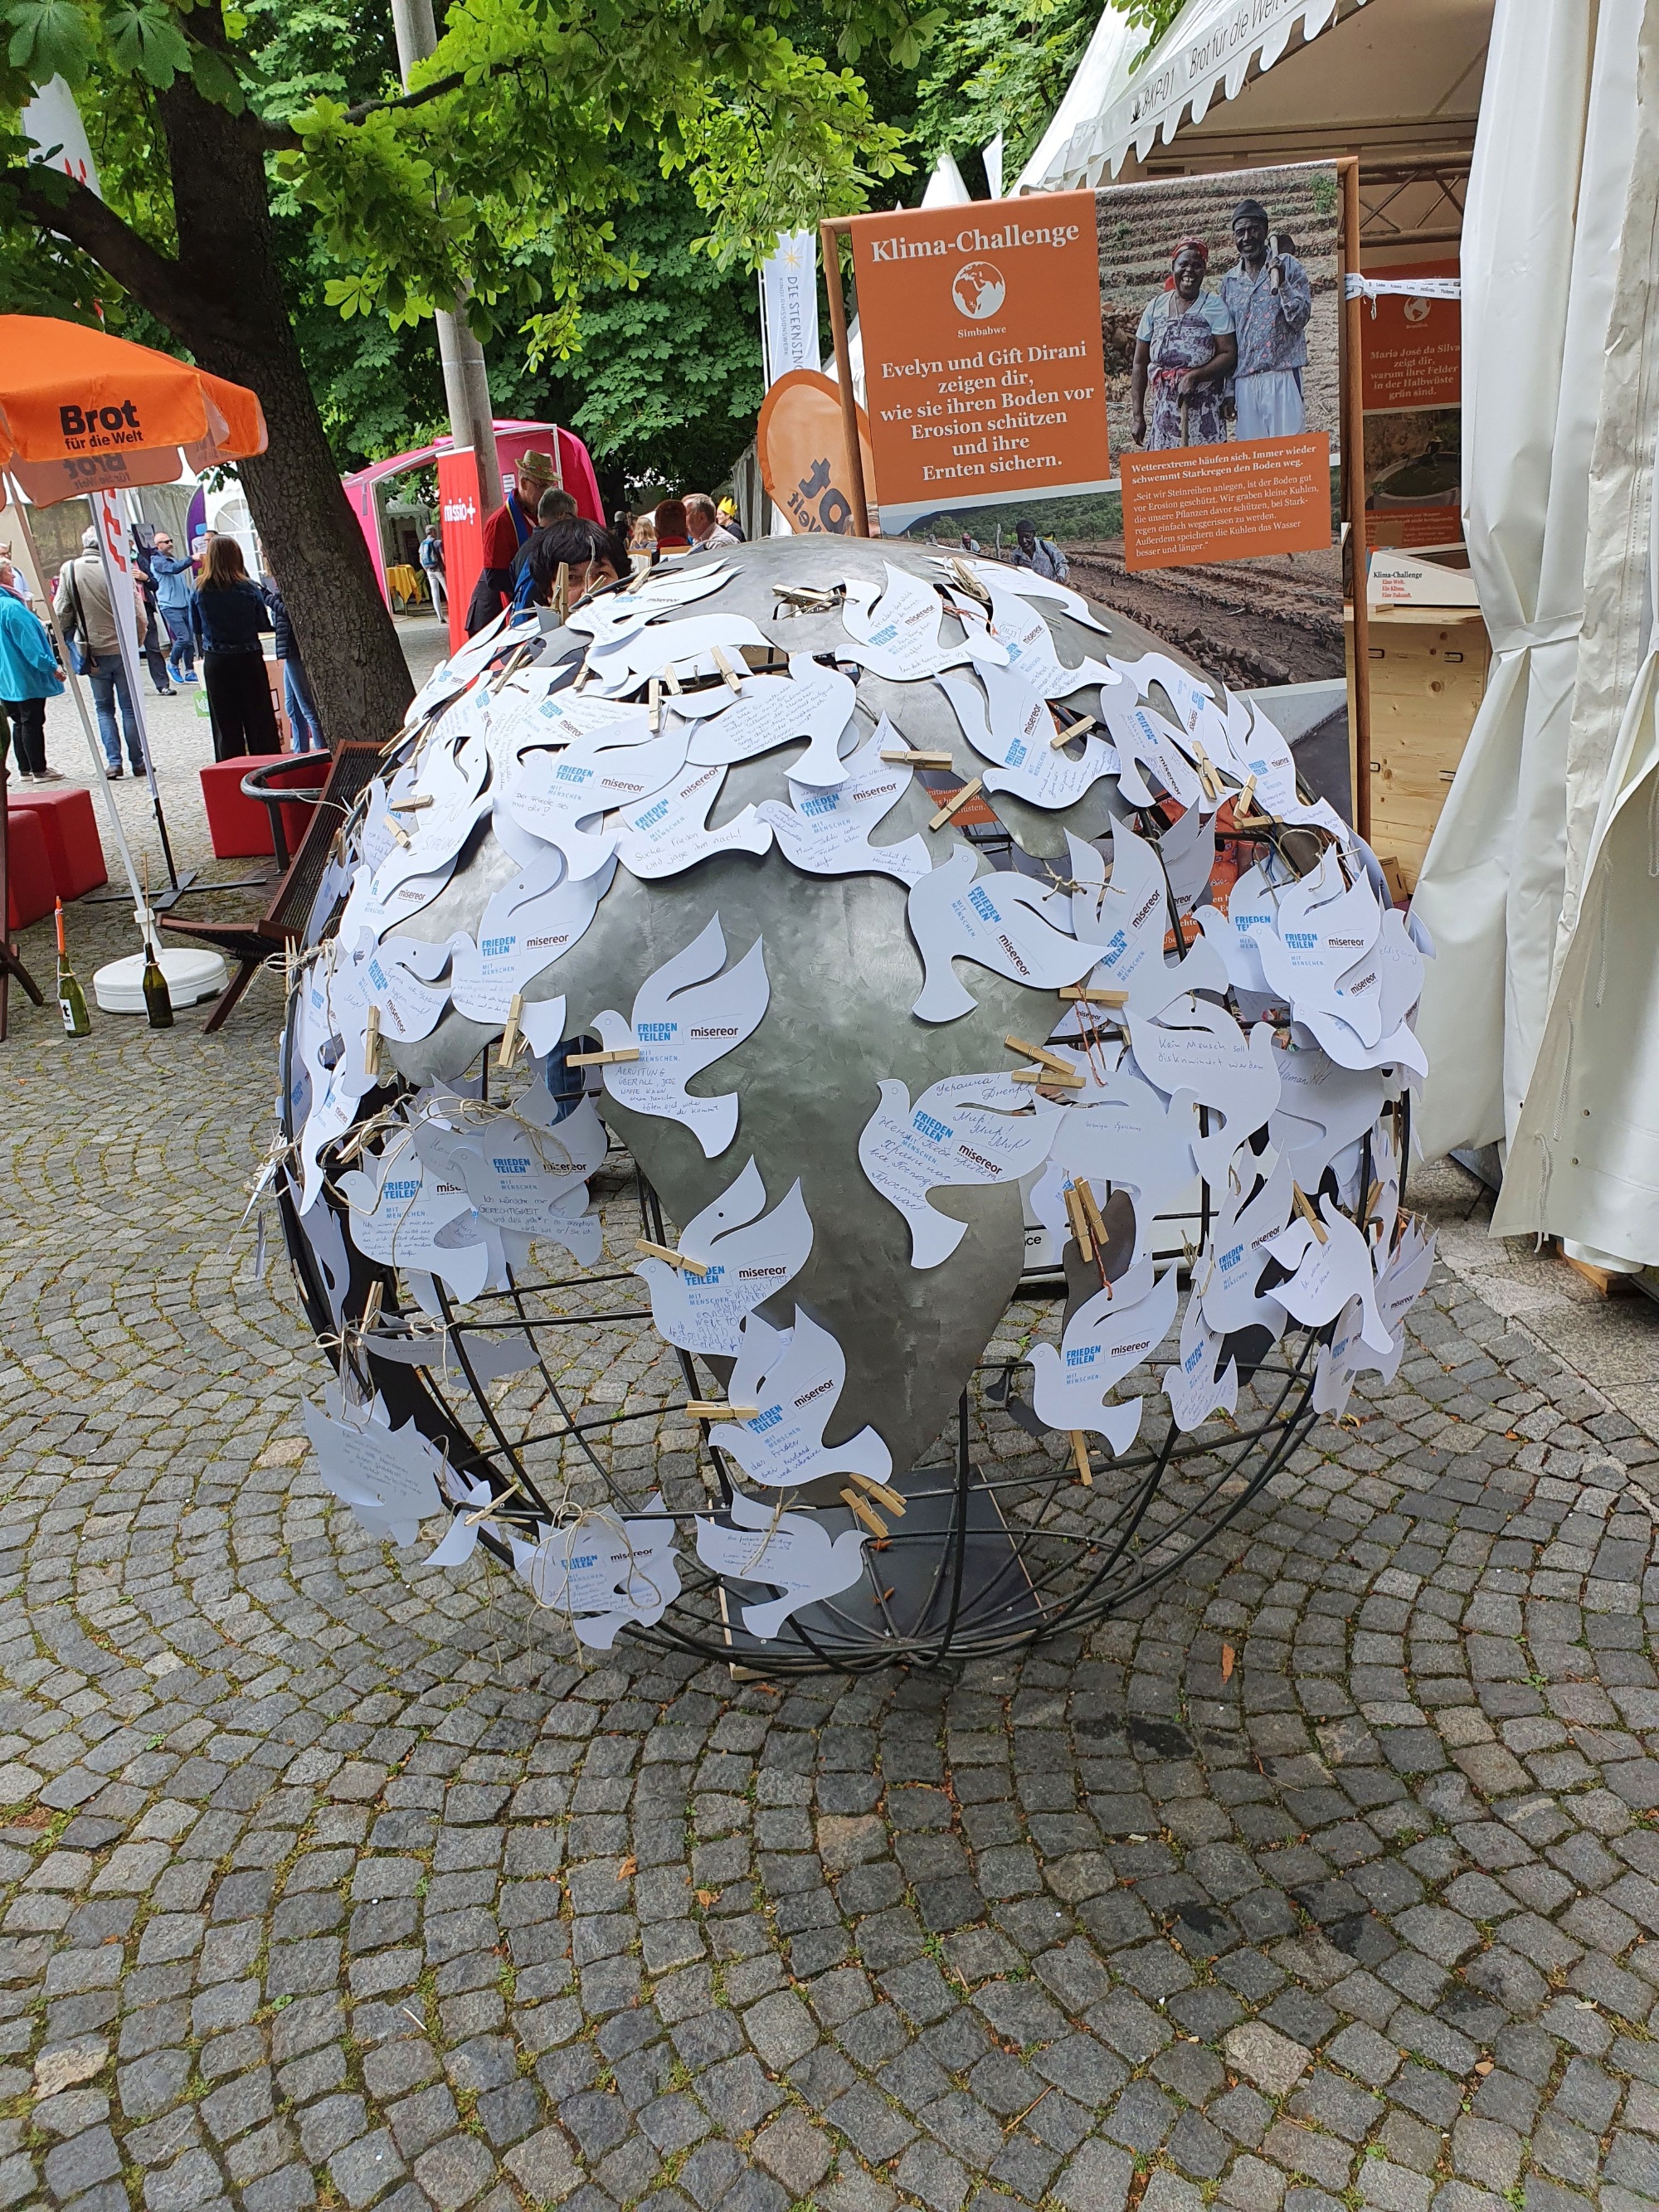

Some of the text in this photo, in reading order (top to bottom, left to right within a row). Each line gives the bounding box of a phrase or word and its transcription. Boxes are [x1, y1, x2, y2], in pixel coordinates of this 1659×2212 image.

[1190, 47, 1210, 79] Brot
[1213, 27, 1228, 61] für
[1230, 8, 1248, 46] die
[871, 224, 1080, 262] Klima-Challenge
[787, 277, 798, 299] DIE
[958, 326, 1006, 338] Simbabwe
[881, 340, 1087, 378] Evelyn und Gift Dirani
[1370, 349, 1398, 359] Maria
[1400, 348, 1421, 357] José
[1438, 344, 1460, 352] Silva
[1394, 357, 1435, 367] zeigt dir,
[938, 370, 1034, 395] zeigen dir,
[1371, 365, 1458, 379] warum ihre Felder
[1404, 377, 1453, 386] Halbwüste
[880, 386, 1095, 421] wie sie ihren Boden vor
[1389, 386, 1437, 400] grün sind.
[60, 400, 140, 435] Brot
[911, 411, 1067, 440] Erosion schützen
[65, 430, 144, 450] für die Welt
[952, 435, 1030, 456] und ihre
[922, 455, 1062, 481] Ernten sichern.
[1131, 445, 1316, 473] Wetterextreme häufen sich. Immer wieder
[1132, 459, 1303, 484] schwemmt Starkregen den Boden weg.
[1153, 489, 1166, 498] wir
[1168, 485, 1212, 498] Steinreihen
[1213, 481, 1246, 493] anlegen,
[1248, 479, 1257, 489] ist
[1258, 477, 1272, 487] der
[1273, 475, 1297, 485] Boden
[1299, 474, 1311, 484] gut
[1134, 484, 1319, 513] vor Erosion geschützt. Wir graben kleine Kuhlen,
[1135, 497, 1308, 523] die unsere Pflanzen davor schützen, bei Stark-
[1136, 526, 1157, 535] regen
[1158, 523, 1186, 533] einfach
[1188, 518, 1233, 529] weggerissen
[1246, 512, 1276, 521] werden.
[1136, 520, 1301, 546] Außerdem speichern die Kuhlen das Wasser
[1136, 547, 1160, 557] besser
[1162, 544, 1177, 554] und
[1024, 703, 1042, 736] misereor
[1005, 738, 1021, 766] FRIEDEN
[1013, 746, 1028, 768] TEILEN
[556, 772, 585, 783] TEILEN
[558, 765, 594, 777] FRIEDEN
[601, 778, 645, 792] misereor
[853, 783, 898, 802] misereor
[800, 793, 839, 810] FRIEDEN
[804, 804, 837, 818] TEILEN
[967, 890, 990, 921] TEILEN
[974, 886, 1001, 923] FRIEDEN
[1132, 889, 1160, 928] misereor
[482, 936, 516, 949] FRIEDEN
[483, 946, 509, 956] TEILEN
[527, 935, 569, 947] misereor
[1329, 938, 1364, 946] misereor
[999, 935, 1030, 975] misereor
[368, 965, 382, 991] TEILEN
[371, 959, 388, 990] FRIEDEN
[387, 999, 406, 1034] misereor
[638, 1023, 677, 1033] FRIEDEN
[639, 1032, 670, 1042] TEILEN
[691, 1027, 738, 1036] misereor
[912, 1118, 942, 1142] TEILEN
[915, 1111, 953, 1138] FRIEDEN
[958, 1144, 1003, 1175] misereor
[684, 1266, 725, 1277] FRDEN
[685, 1276, 719, 1286] TEILEN
[739, 1266, 787, 1278] misereor
[1066, 1345, 1101, 1359] FRIEDEN
[1111, 1339, 1150, 1355] misereor
[1067, 1355, 1094, 1367] TEILEN
[794, 1378, 834, 1407] misereor
[747, 1404, 783, 1428] FRIEDEN
[752, 1414, 783, 1434] TEILEN
